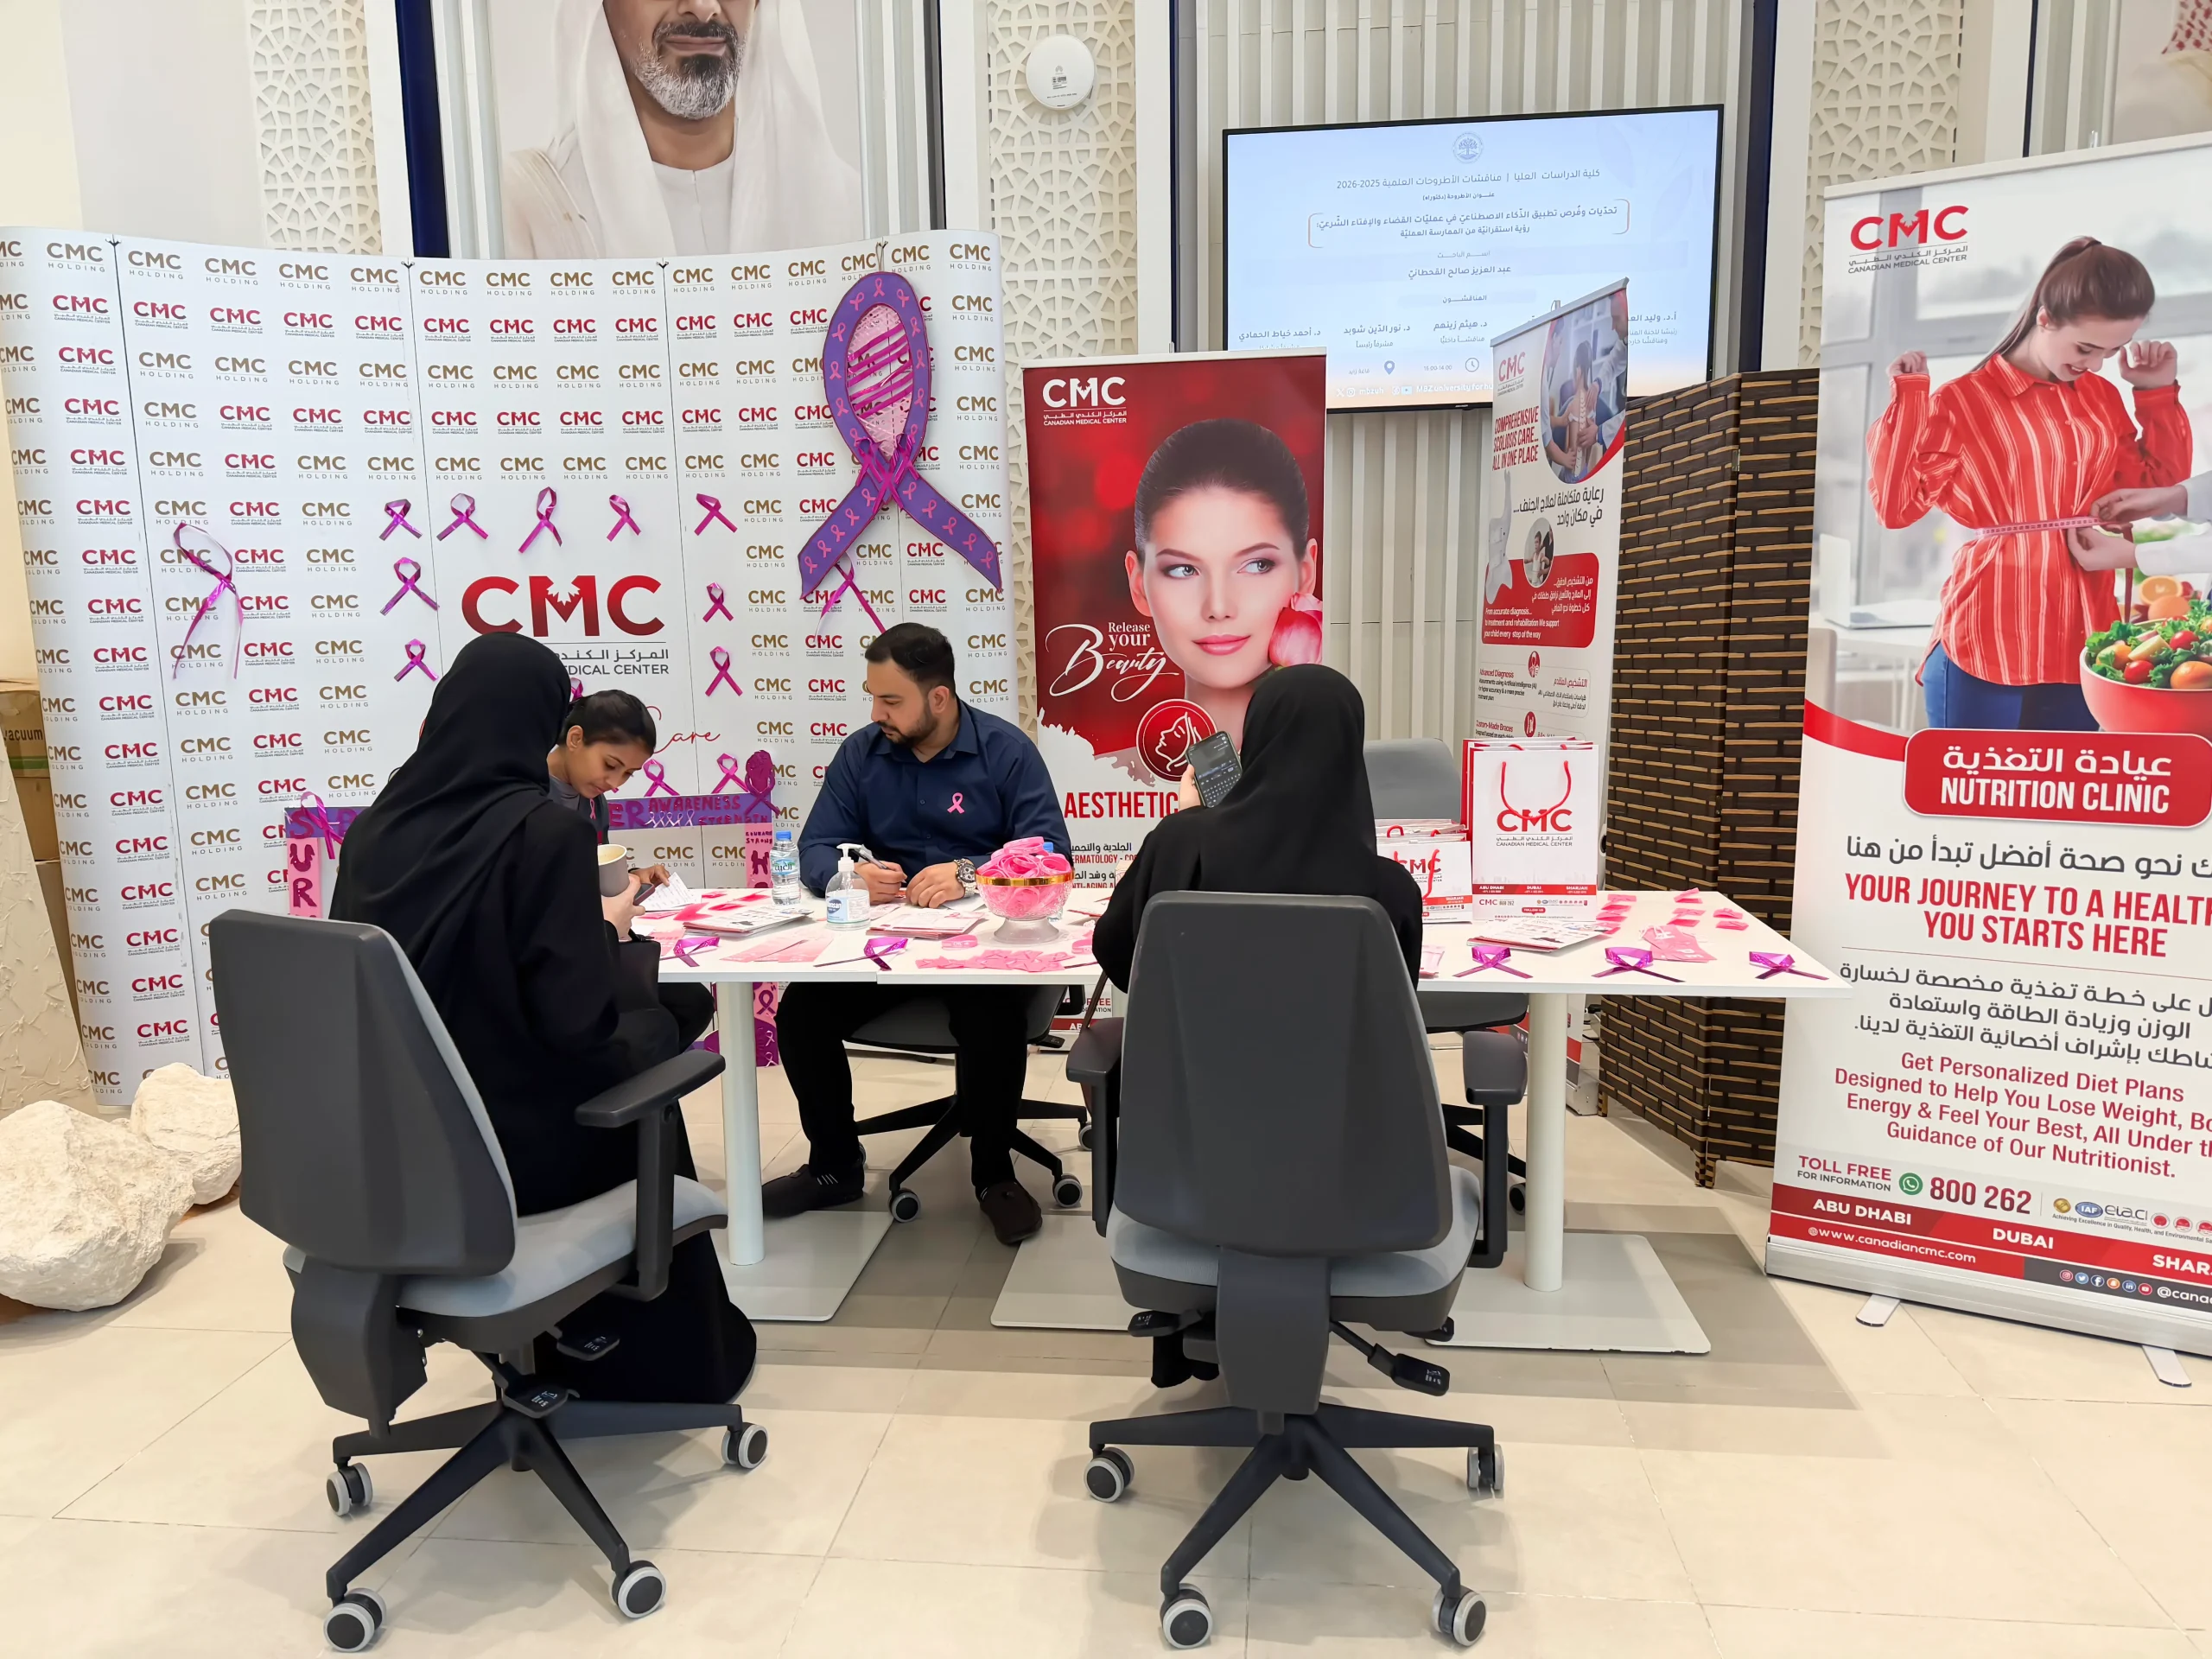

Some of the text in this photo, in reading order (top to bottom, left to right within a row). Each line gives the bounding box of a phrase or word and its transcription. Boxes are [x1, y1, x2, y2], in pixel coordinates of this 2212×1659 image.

[1382, 178, 1414, 188] العلمية
[1416, 175, 1459, 187] الأطروحات
[1462, 173, 1502, 183] مناقشات
[1514, 171, 1536, 182] العليا
[1541, 169, 1580, 181] الدراسات
[1582, 168, 1600, 178] كلية
[1382, 216, 1412, 225] القضاء
[1446, 213, 1457, 226] في
[1531, 209, 1558, 219] تطبيق
[1428, 228, 1463, 238] الممارسة
[1515, 225, 1530, 234] رؤية
[1851, 206, 1969, 251] CMC
[47, 243, 103, 262] CMC
[950, 244, 991, 262] CMC
[1934, 245, 1968, 257] المركز
[48, 263, 105, 273] HOLDING
[279, 264, 328, 281] CMC
[950, 263, 992, 271] HOLDING
[1447, 266, 1511, 277] عبد العزيز صالح
[1848, 254, 1967, 274] CANADIAN MEDICAL CENTER
[280, 282, 330, 290] HOLDING
[550, 272, 593, 287] CMC
[553, 319, 596, 334] CMC
[1238, 331, 1269, 342] الحمادي
[1293, 327, 1312, 337] أحمد
[139, 352, 192, 370] CMC
[1498, 352, 1526, 382] CMC
[140, 371, 194, 379] HOLDING
[1042, 377, 1126, 408] CMC
[957, 397, 996, 411] CMC
[1495, 406, 1539, 434] COMPREHENSIVE
[1493, 431, 1517, 453] SCOLIOSIS
[297, 455, 346, 470] CMC
[797, 452, 835, 467] CMC
[1492, 445, 1539, 471] ALL ONE PLACE
[1557, 486, 1605, 506] رعاية متكاملة
[1571, 508, 1588, 527] مكان
[1590, 505, 1603, 528] في
[461, 575, 665, 637] CMC
[1108, 621, 1150, 632] Release
[752, 635, 788, 649] CMC
[1109, 632, 1150, 652] your
[613, 648, 669, 663] المركز
[1046, 623, 1179, 702] Beauty
[613, 664, 669, 675] CENTER
[320, 685, 366, 700] CMC
[99, 695, 153, 711] CMC
[1943, 745, 2172, 782] عيادة التغذية
[111, 790, 163, 806] CMC
[648, 796, 741, 813] AWARENESS
[1064, 791, 1179, 818] AESTHETIC
[1941, 777, 2170, 814] NUTRITION CLINIC
[1497, 809, 1573, 832] CMC
[1103, 842, 1132, 853] الجلدية
[1847, 835, 1881, 859] هنا
[1889, 838, 1923, 865] من
[1931, 834, 1974, 862] تبدأ
[1980, 841, 2050, 870] أفضل
[2059, 847, 2125, 874] صحة
[2135, 854, 2183, 880] نحو
[1845, 873, 1910, 904] YOUR
[1917, 878, 2037, 913] JOURNEY
[2044, 886, 2078, 916] TO
[2085, 889, 2105, 918] A
[1923, 911, 2168, 957] YOU STARTS HERE
[1840, 963, 1910, 986] لخسارة
[1916, 969, 2003, 994] مخصصة
[2011, 977, 2078, 1002] تغذية
[2082, 986, 2145, 1007] خطة
[2152, 993, 2191, 1013] على
[1889, 992, 2190, 1040] الوزن وزيادة الطاقة واستعادة
[1905, 1019, 1974, 1042] التغذية
[1980, 1026, 2059, 1052] أخصائية
[2065, 1038, 2142, 1065] بإشراف
[1900, 1052, 2184, 1103] Get Personalized Diet Plans
[1834, 1067, 1923, 1096] Designed
[1928, 1078, 1948, 1097] to
[1954, 1083, 1999, 1108] Help
[2004, 1088, 2041, 1109] You
[2046, 1093, 2097, 1117] Lose
[2101, 1100, 2183, 1131] Weight,
[1847, 1093, 1912, 1120] Energy
[1917, 1103, 1933, 1120] &
[1938, 1104, 1980, 1126] Feel
[1986, 1110, 2031, 1134] Your
[2037, 1116, 2088, 1143] Best,
[2093, 1125, 2121, 1145] All
[2126, 1128, 2193, 1154] Under
[1886, 1122, 1978, 1151] Guidance
[1983, 1132, 2004, 1154] of
[2009, 1138, 2046, 1160] Our
[2051, 1143, 2176, 1179] Nutritionist.
[1798, 1155, 1891, 1181] TOLL FREE
[1797, 1170, 1891, 1192] FOR INFORMATION
[1929, 1176, 2032, 1215] 800 262
[1813, 1199, 1911, 1225] ABU DHABI
[2081, 1205, 2099, 1214] IAF
[2052, 1213, 2077, 1223] Achieving
[2078, 1218, 2107, 1227] Excellence
[2113, 1223, 2133, 1232] Quality,
[2134, 1226, 2153, 1235] Health,
[2165, 1231, 2204, 1243] Environmental
[1818, 1228, 1976, 1264] www.canadiancmc.com
[1993, 1228, 2054, 1249] DUBAI
[2152, 1254, 2212, 1276] SHAR
